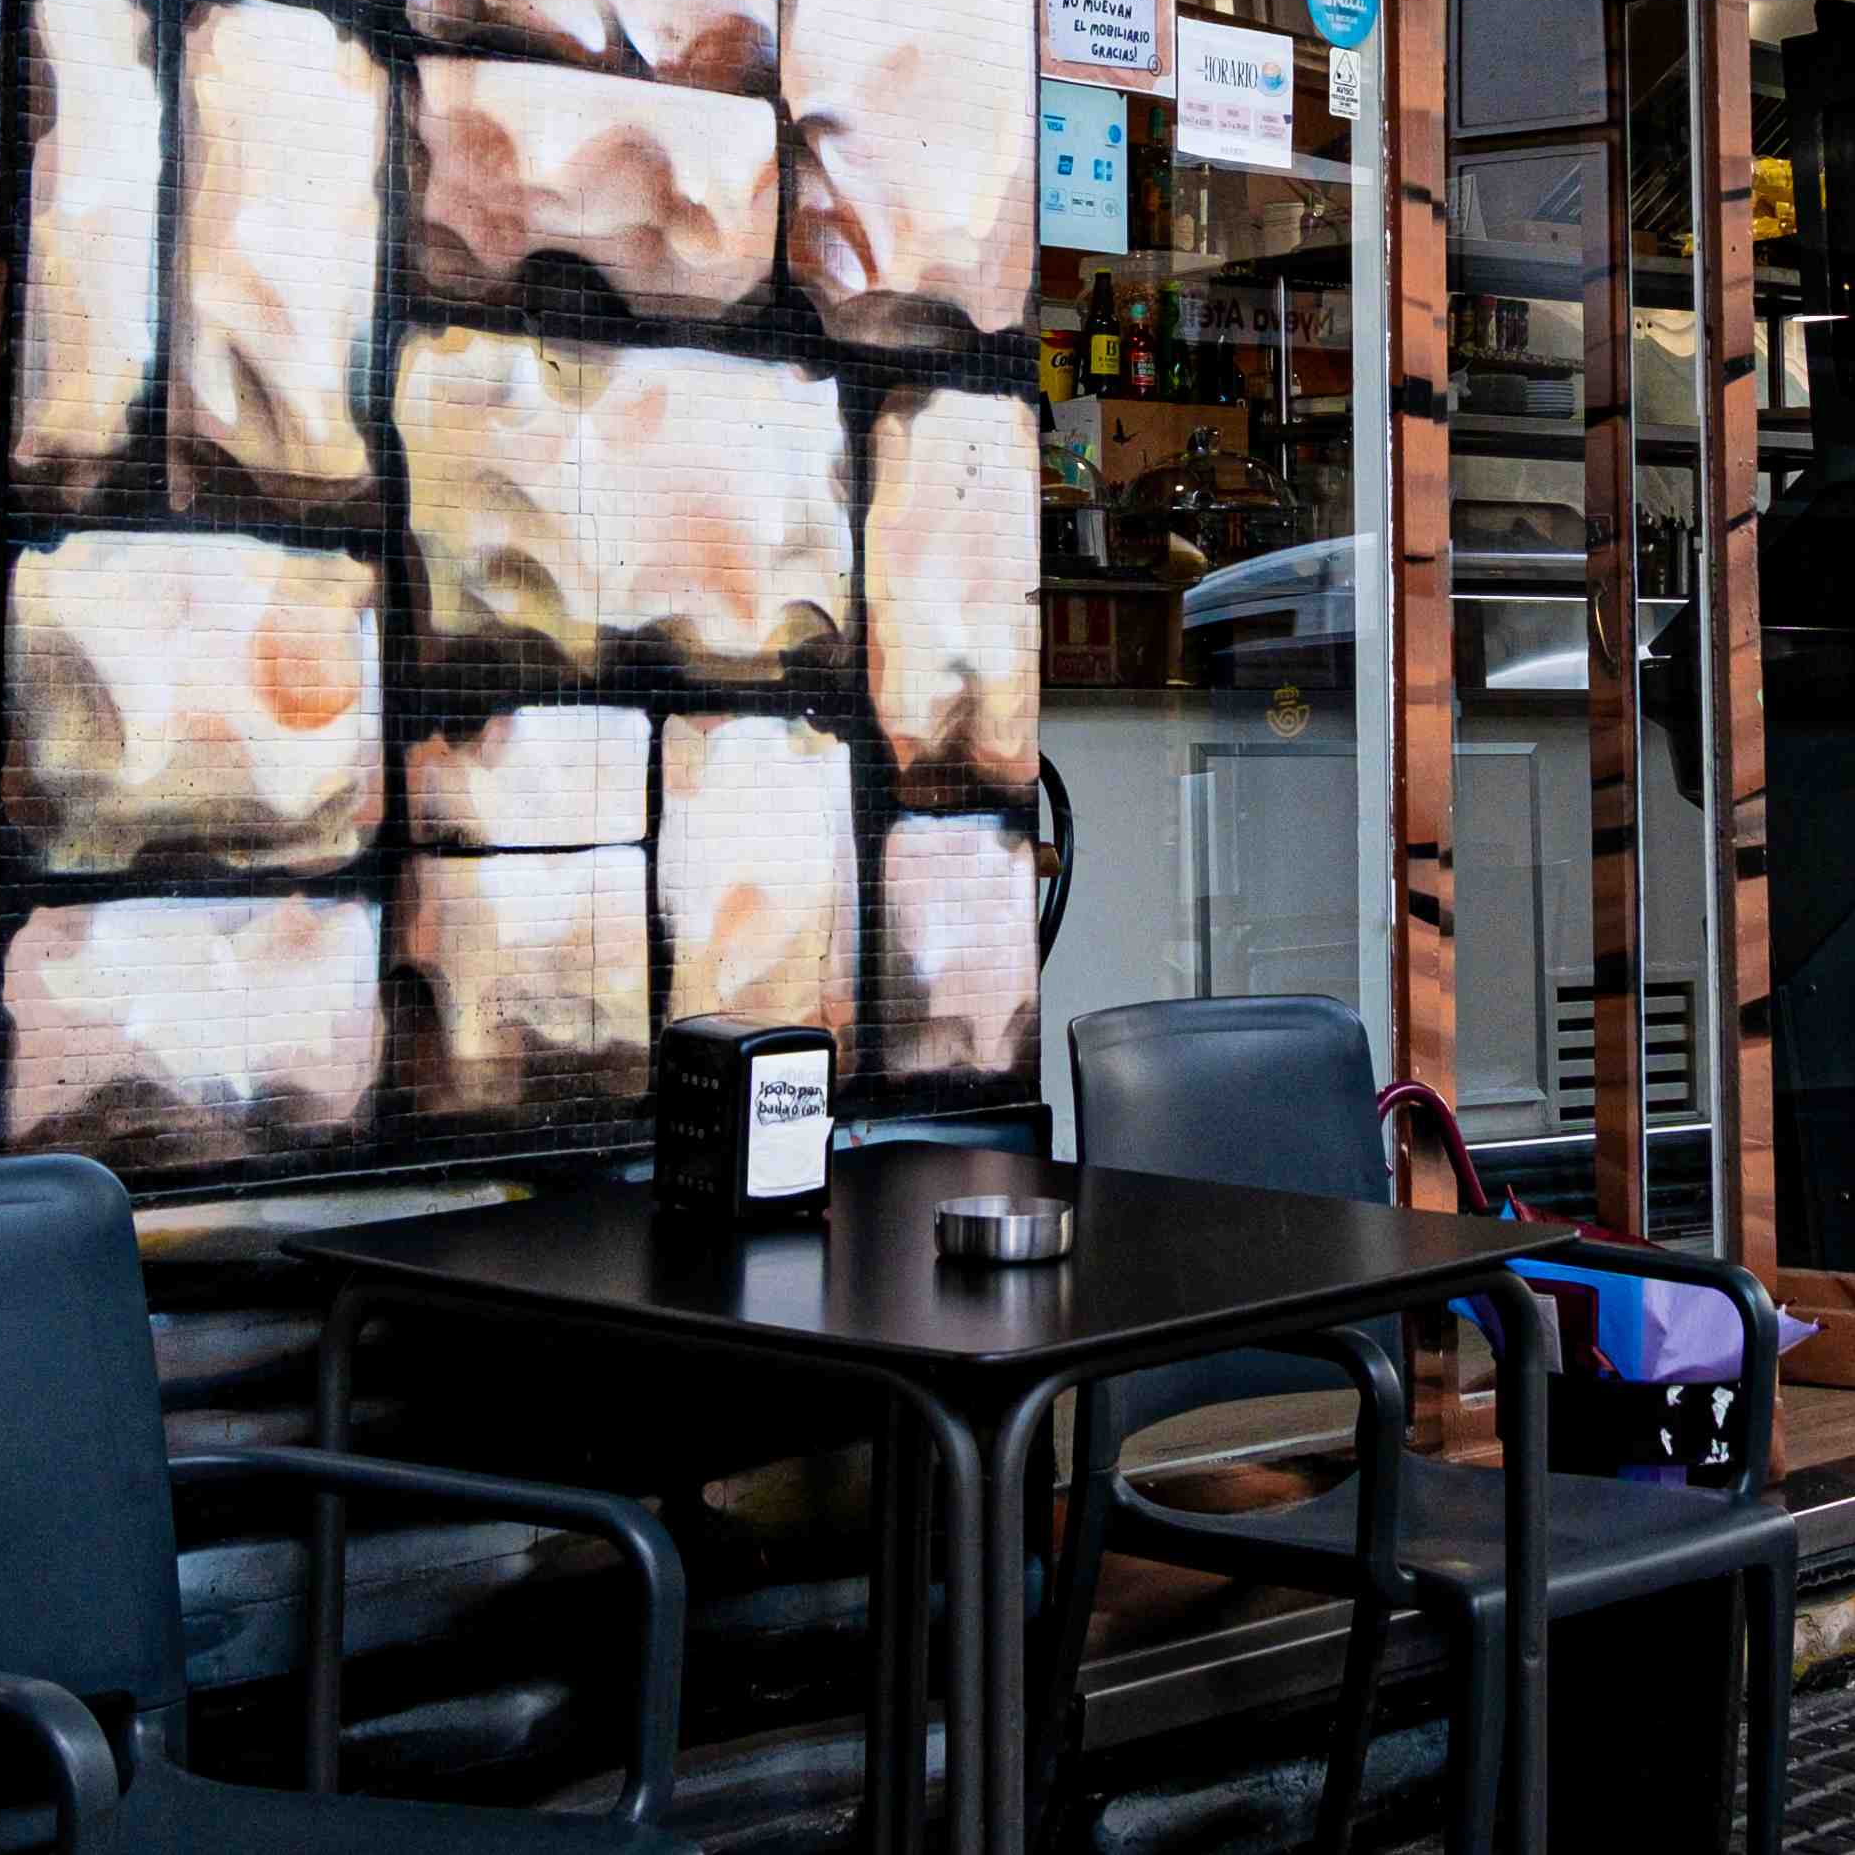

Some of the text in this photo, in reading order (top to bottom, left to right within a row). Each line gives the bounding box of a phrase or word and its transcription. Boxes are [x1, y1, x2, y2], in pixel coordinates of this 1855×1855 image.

[1074, 19, 1151, 44] EL MOBILIARIO
[1091, 43, 1138, 63] GRACIAS!
[1199, 54, 1258, 90] HORARIO
